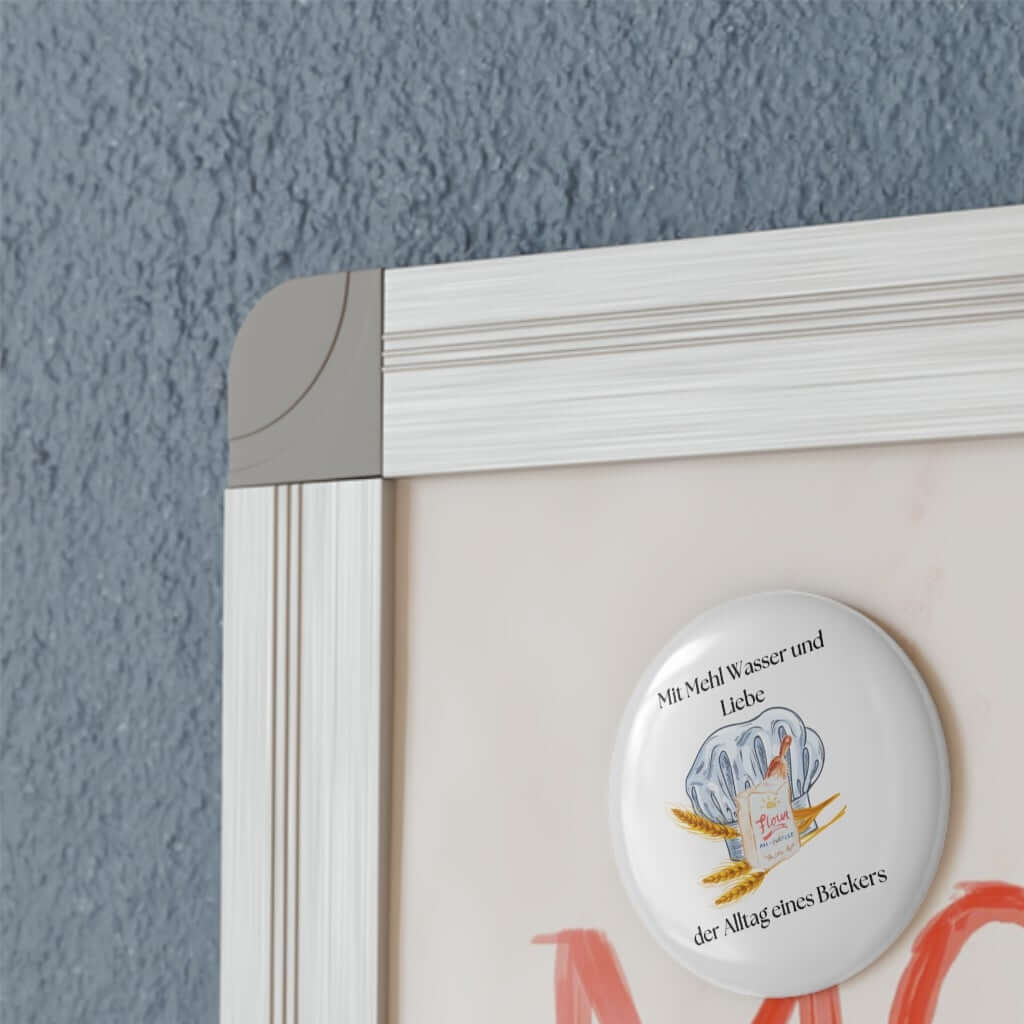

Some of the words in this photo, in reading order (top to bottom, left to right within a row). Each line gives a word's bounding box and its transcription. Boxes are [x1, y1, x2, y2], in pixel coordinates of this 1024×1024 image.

[657, 685, 684, 709] Mit
[684, 667, 726, 697] Mehl
[726, 648, 787, 683] Wasser
[790, 629, 825, 660] und
[720, 687, 766, 717] Liebe
[693, 925, 719, 946] der
[723, 906, 770, 936] Alltag
[771, 892, 815, 919] eines
[817, 869, 888, 904] Bäckers
